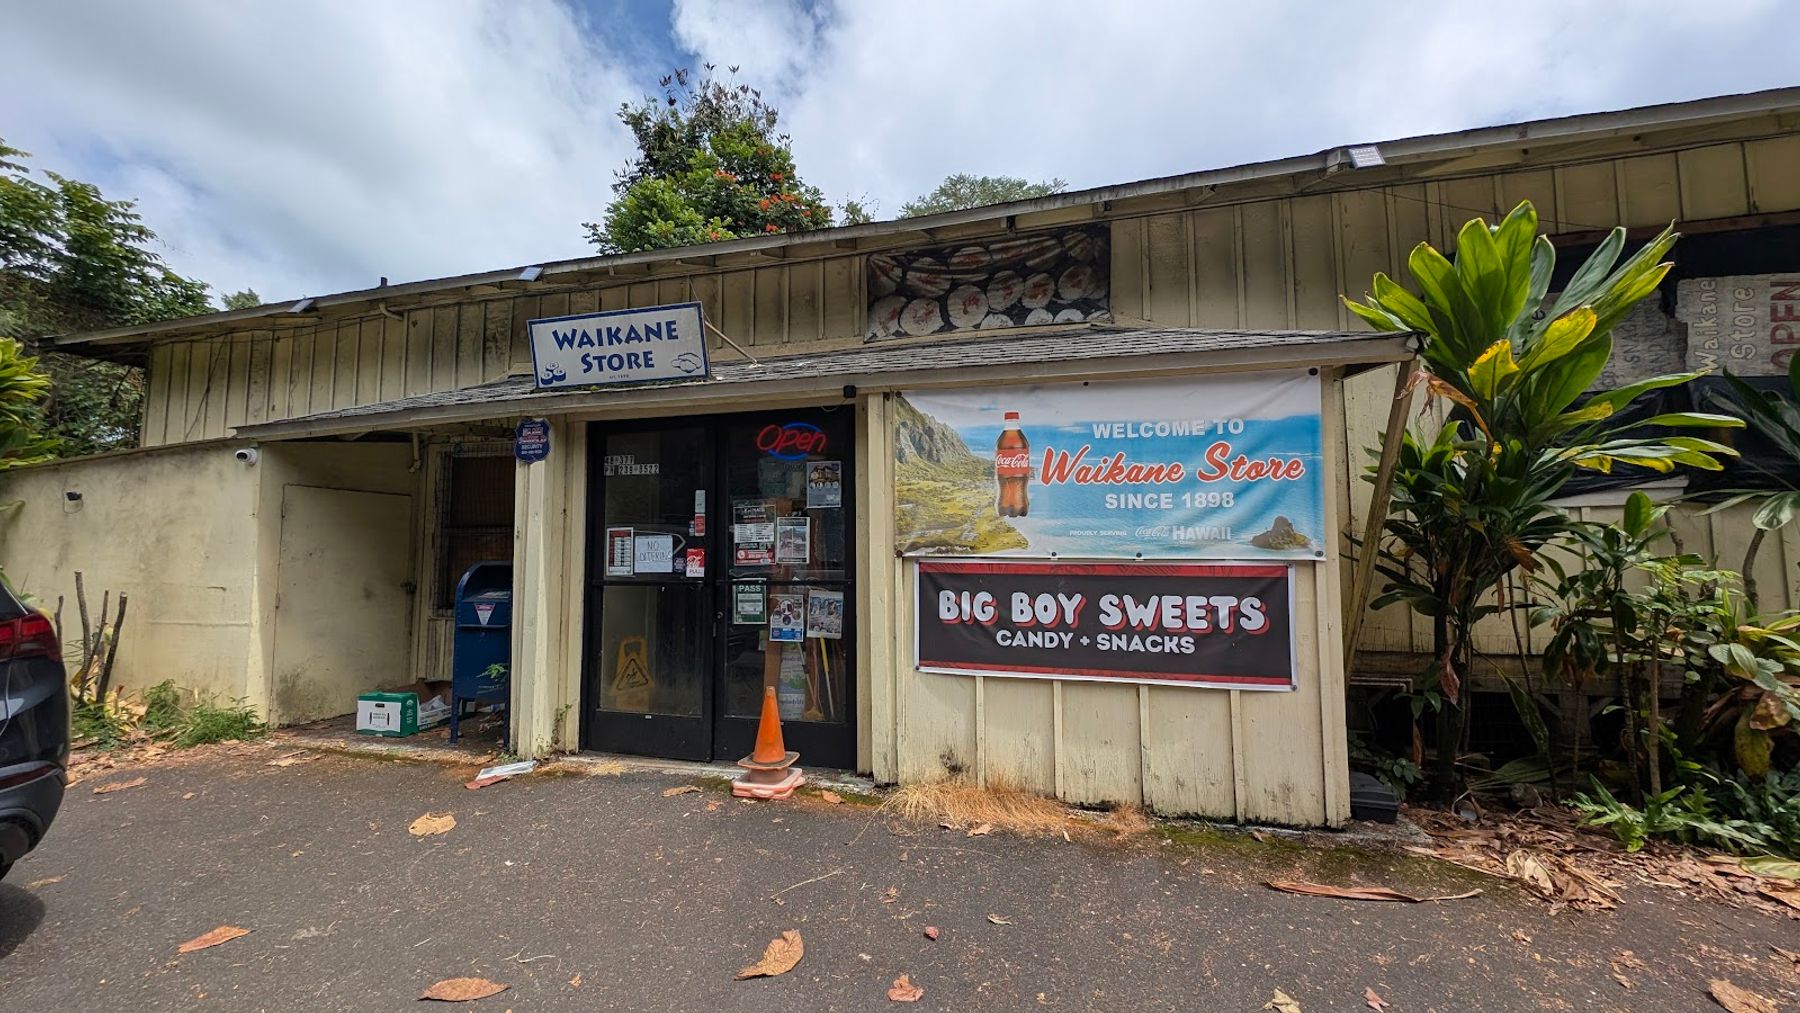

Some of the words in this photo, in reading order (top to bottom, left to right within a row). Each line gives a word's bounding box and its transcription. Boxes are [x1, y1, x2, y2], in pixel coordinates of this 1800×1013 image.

[552, 319, 679, 351] WAIKANE
[1693, 279, 1720, 374] Waikane
[1728, 287, 1758, 361] Store
[580, 349, 656, 375] STORE
[1093, 419, 1206, 440] WELCOME
[1212, 418, 1245, 435] TO
[1041, 445, 1184, 487] Waikane
[1197, 441, 1306, 482] Store
[1104, 493, 1173, 509] SINCE
[1180, 491, 1235, 509] 1898
[1172, 525, 1232, 541] HAWAII
[938, 590, 998, 623] BIG
[1011, 592, 1085, 629] BOY
[1098, 594, 1270, 635] SWEETS
[995, 630, 1074, 649] CANDY
[1096, 633, 1196, 655] SNACKS
